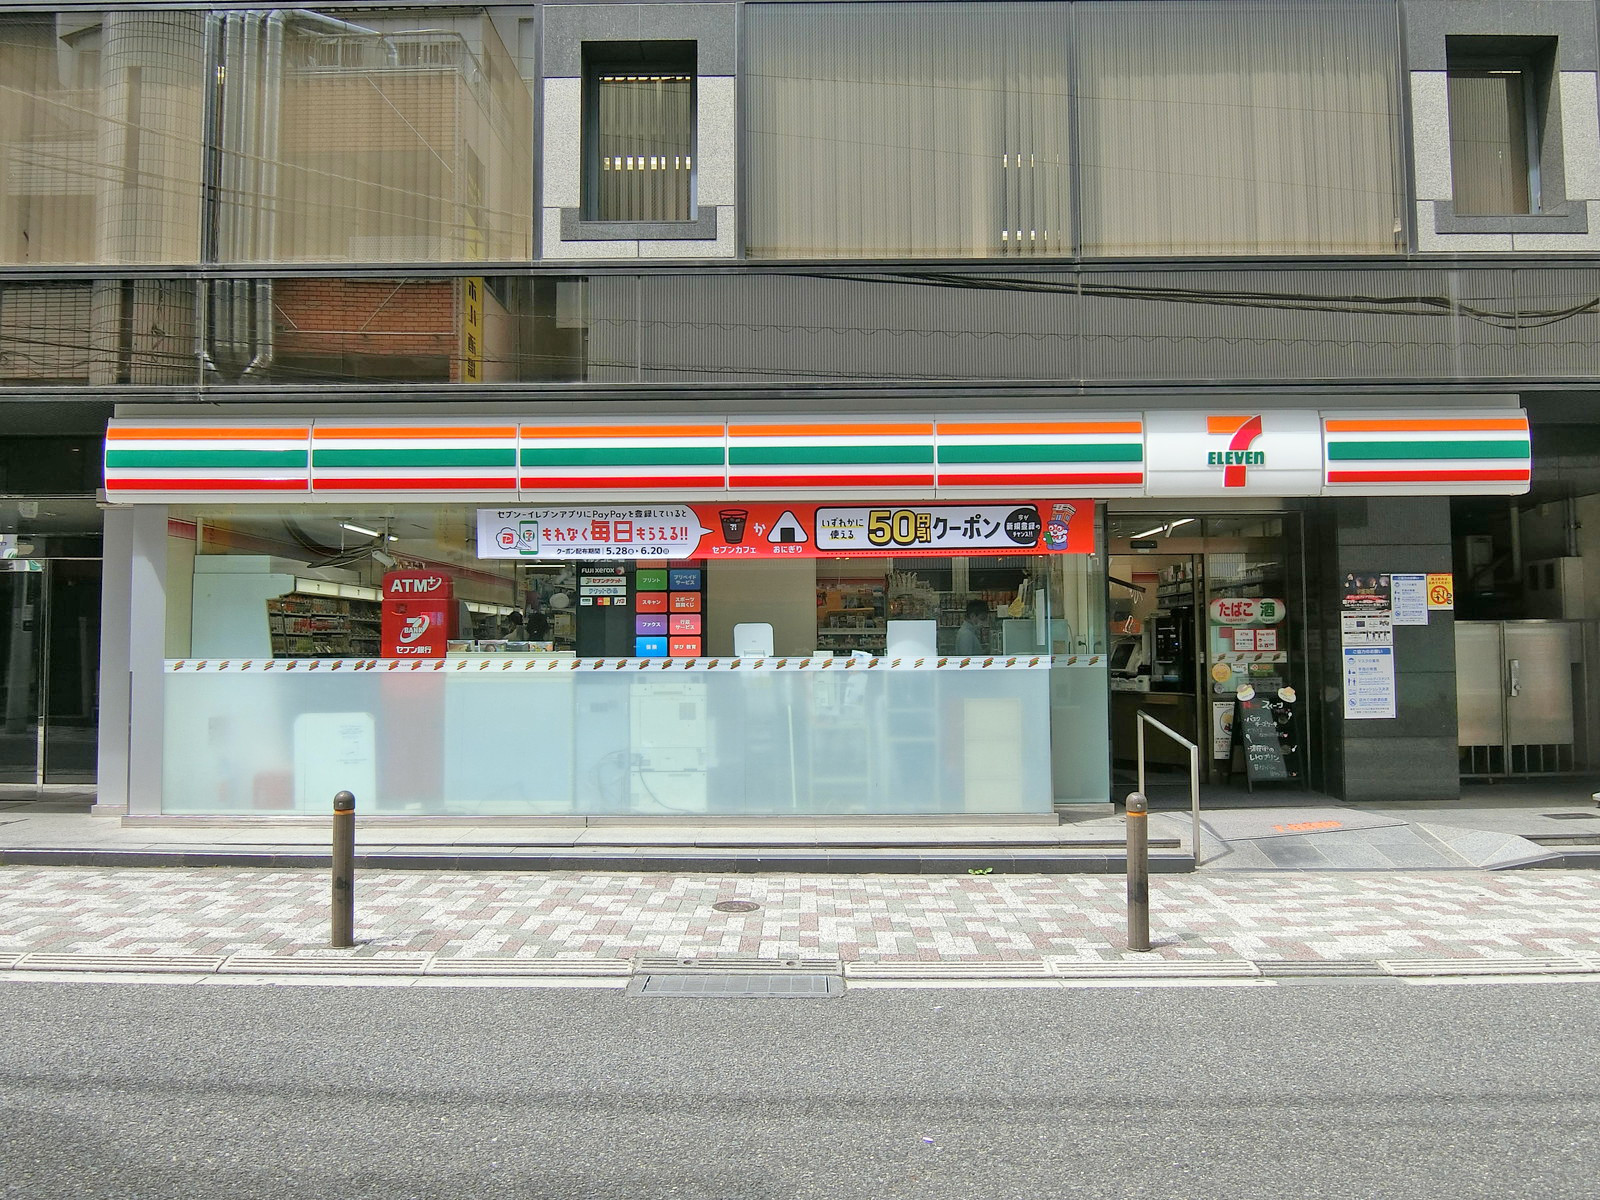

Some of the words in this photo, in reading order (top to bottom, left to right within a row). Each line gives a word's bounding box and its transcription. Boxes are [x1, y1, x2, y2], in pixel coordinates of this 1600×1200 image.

[1206, 414, 1262, 487] 7
[820, 517, 864, 528] いずれかに
[753, 523, 766, 537] か
[829, 530, 854, 540] 使える
[712, 546, 757, 554] セブンカフェ
[773, 545, 803, 554] おにぎり
[1219, 602, 1254, 617] たばこ
[1260, 602, 1275, 617] 酒
[396, 646, 432, 654] セブン銀行
